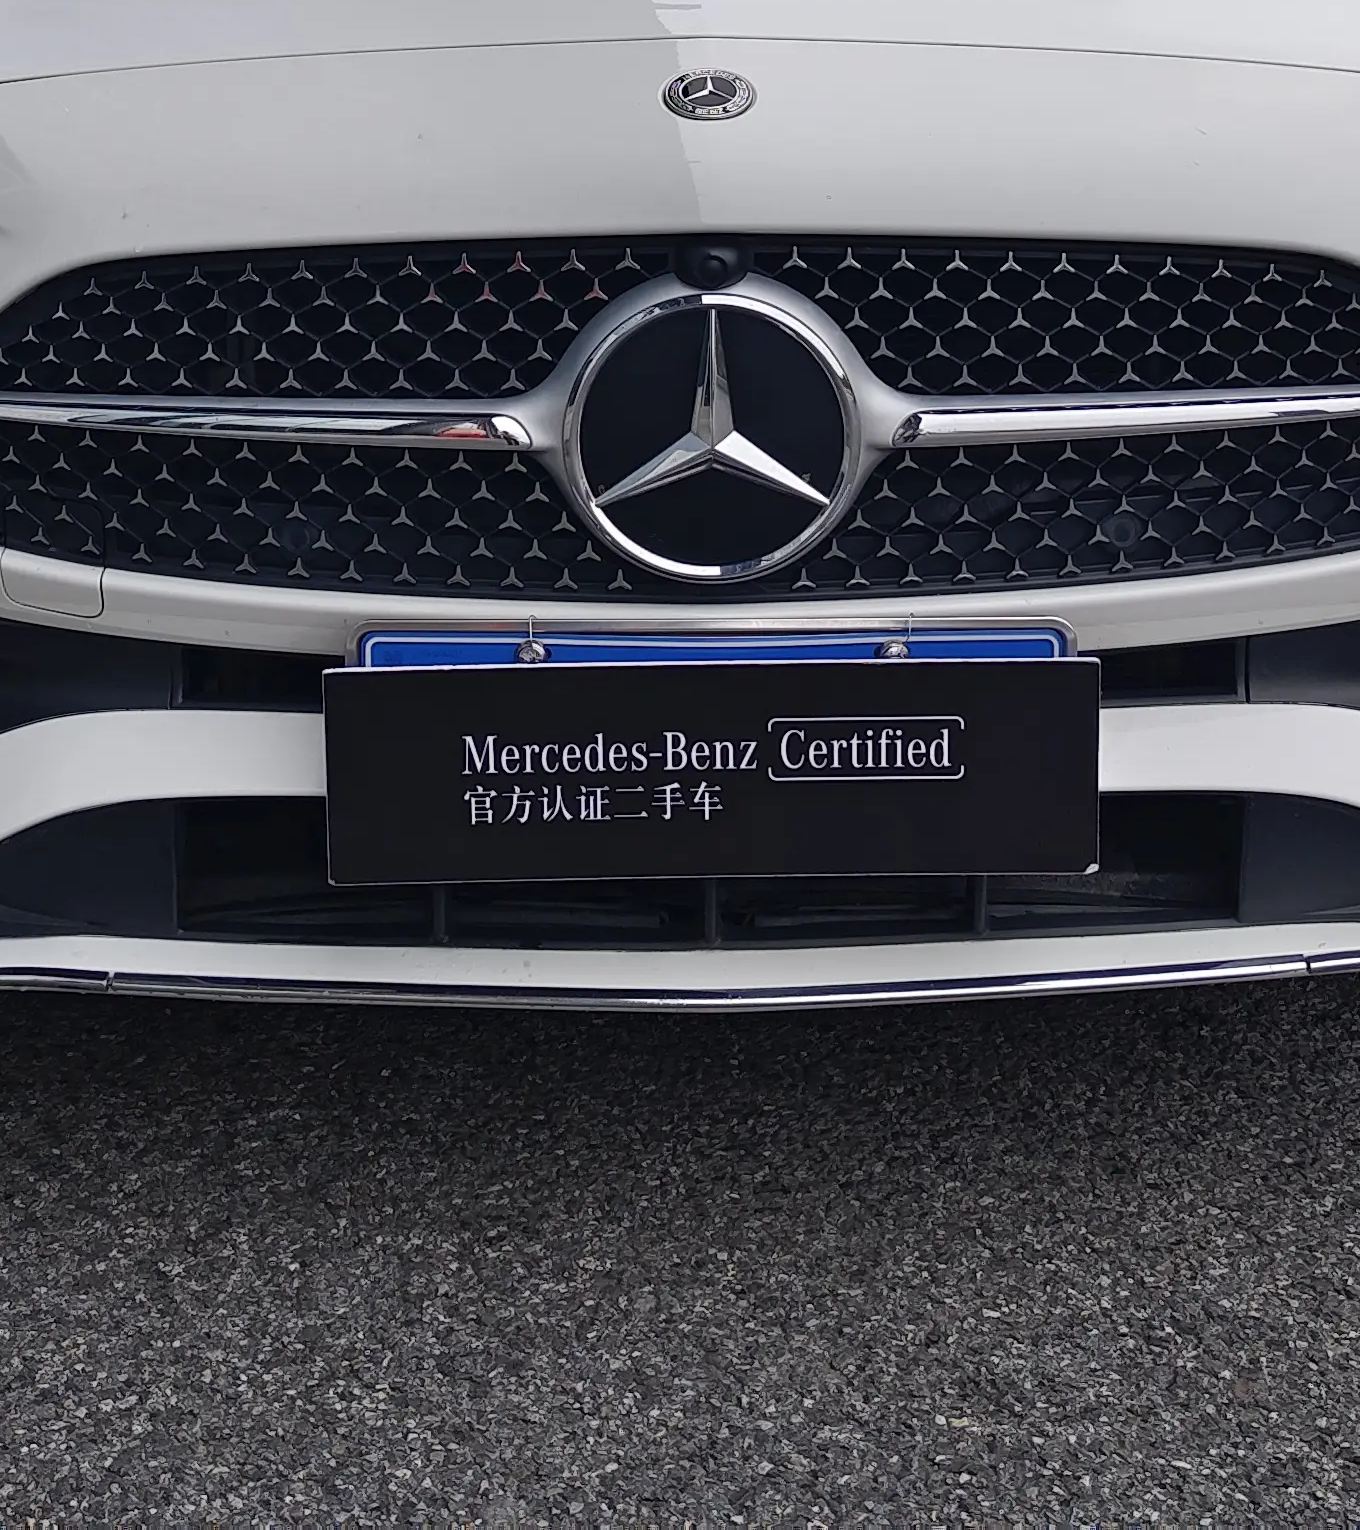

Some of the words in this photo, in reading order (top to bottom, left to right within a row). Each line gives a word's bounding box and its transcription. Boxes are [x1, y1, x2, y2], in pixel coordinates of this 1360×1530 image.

[461, 730, 758, 775] Mercedes-Benz
[780, 728, 952, 769] Certified
[463, 781, 724, 825] 官方认证二手车
